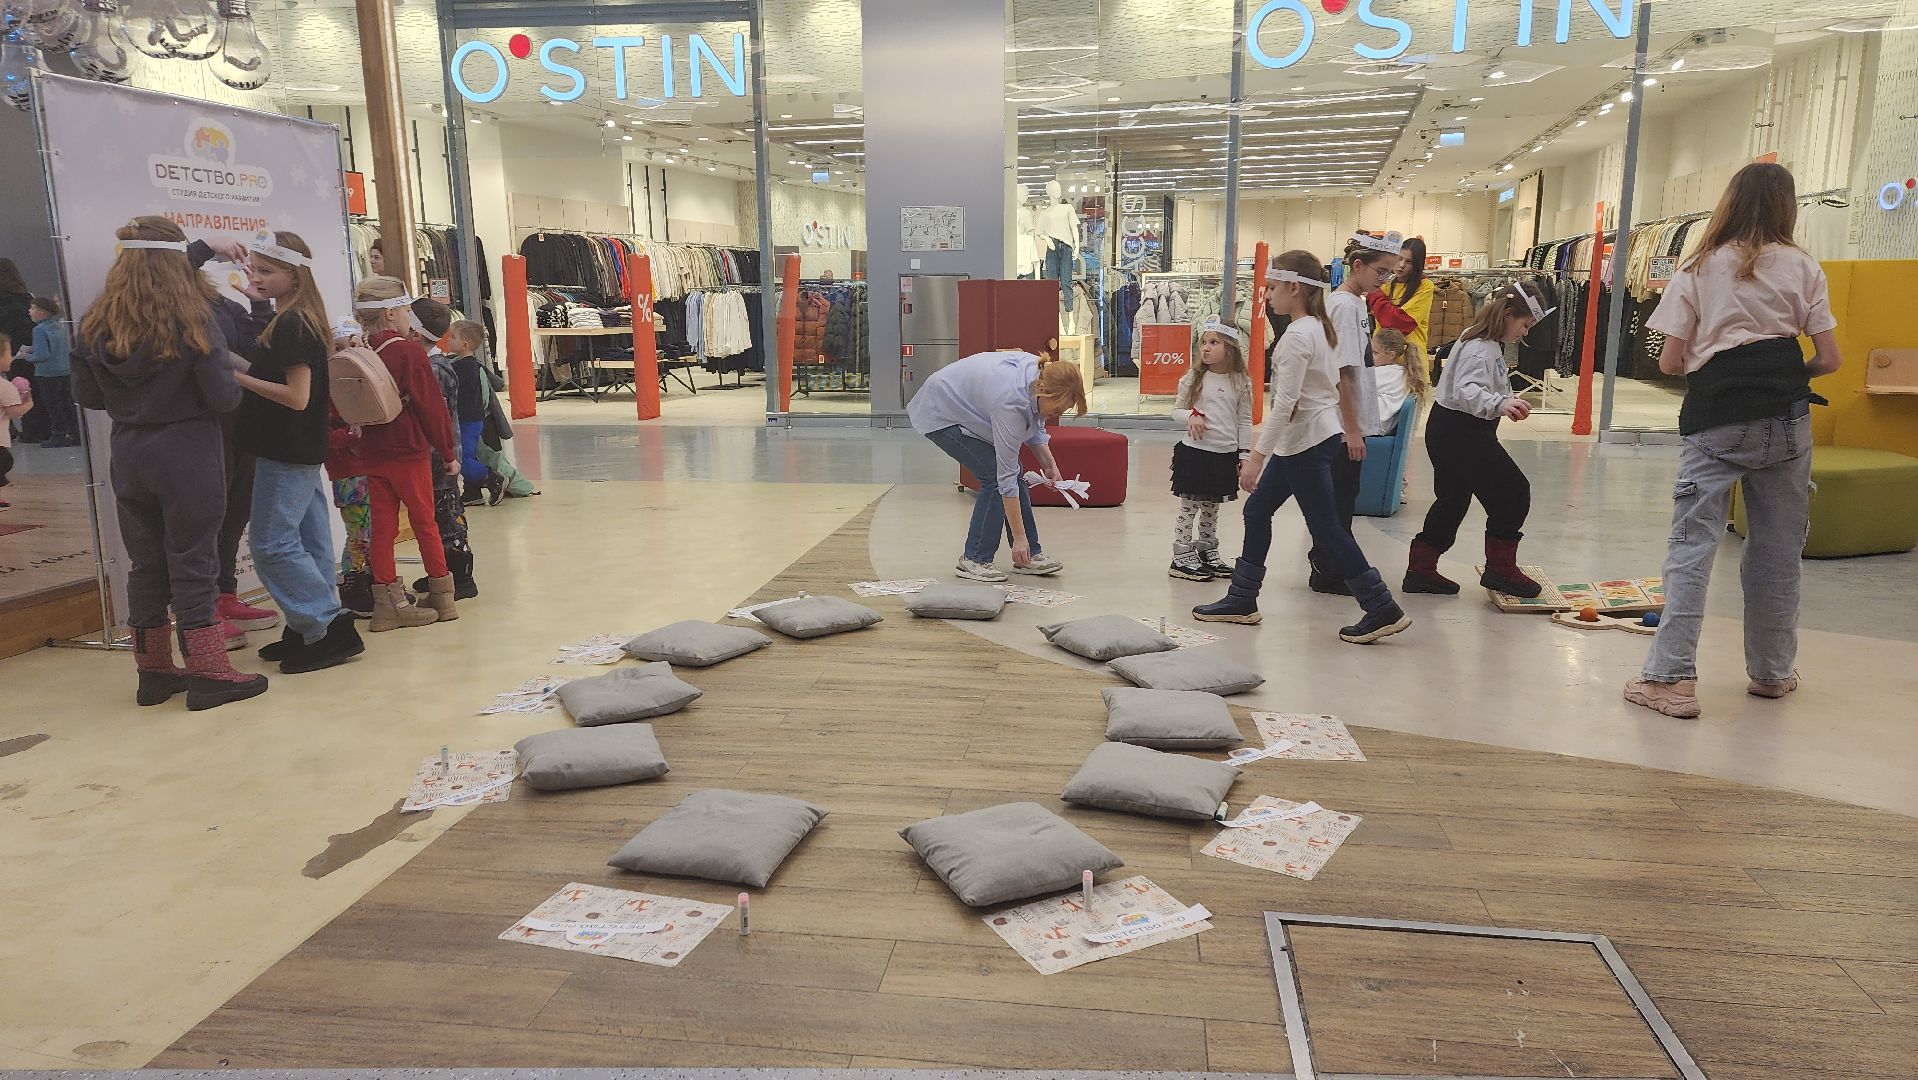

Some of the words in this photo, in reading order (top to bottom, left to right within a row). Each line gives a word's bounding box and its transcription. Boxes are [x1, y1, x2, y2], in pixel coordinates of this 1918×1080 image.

[451, 32, 746, 103] O'STIN
[171, 188, 197, 198] СТУДИЯ
[198, 190, 230, 200] ДЕТСКОГО
[231, 194, 261, 203] РАЗВИТИЯ
[802, 220, 855, 248] O'STIN
[1152, 352, 1185, 366] 70%
